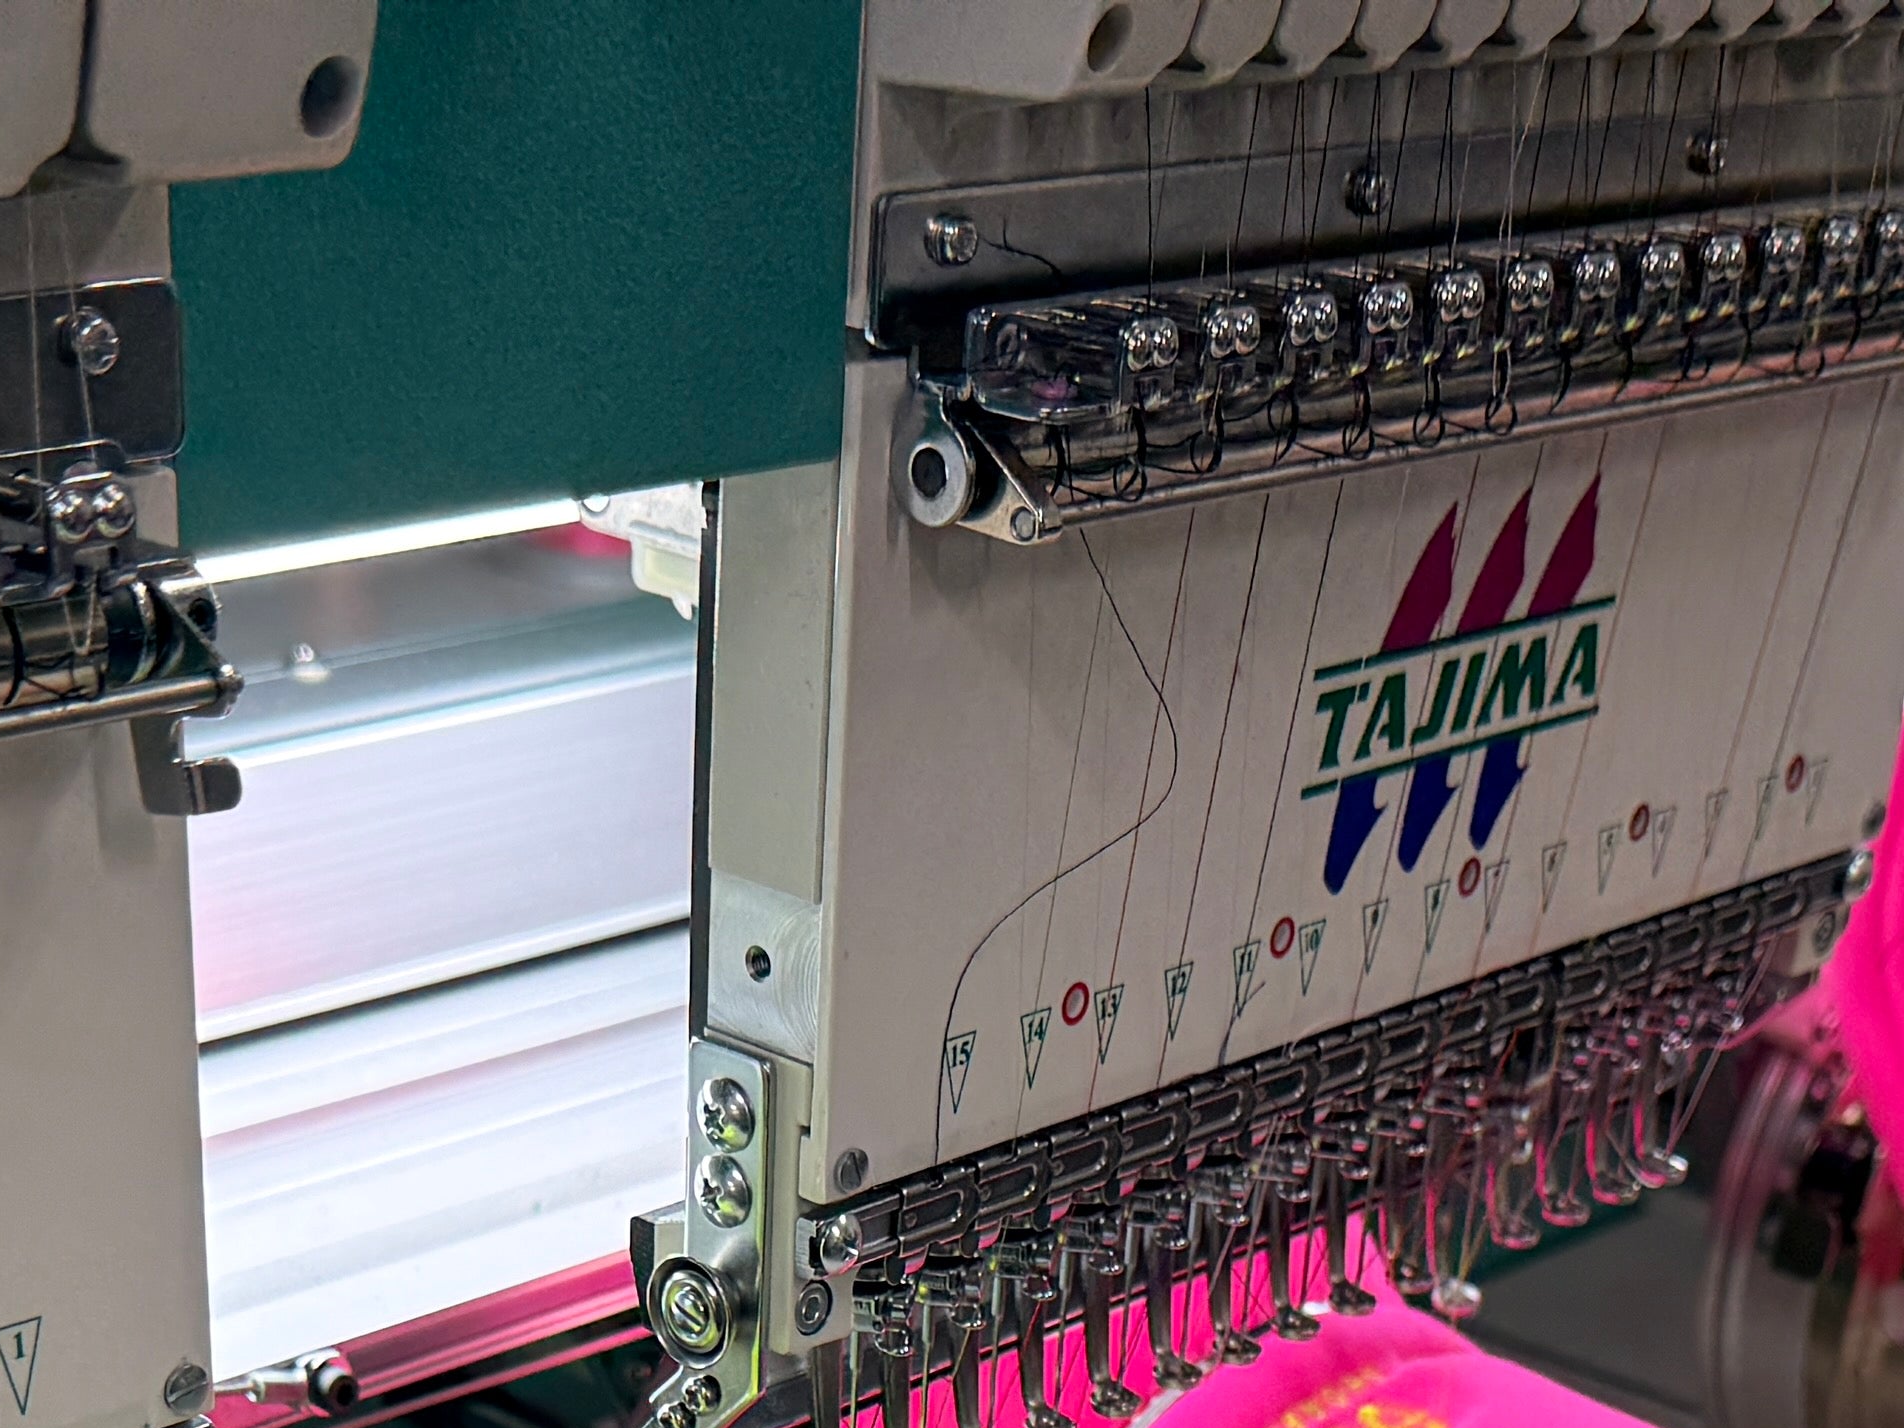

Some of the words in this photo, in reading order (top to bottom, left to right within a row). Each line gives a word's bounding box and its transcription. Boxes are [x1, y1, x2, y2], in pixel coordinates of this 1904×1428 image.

[1314, 622, 1599, 773] TAJIMA
[1026, 1018, 1045, 1045] 14
[950, 1039, 972, 1069] 15
[13, 1331, 26, 1360] 1
